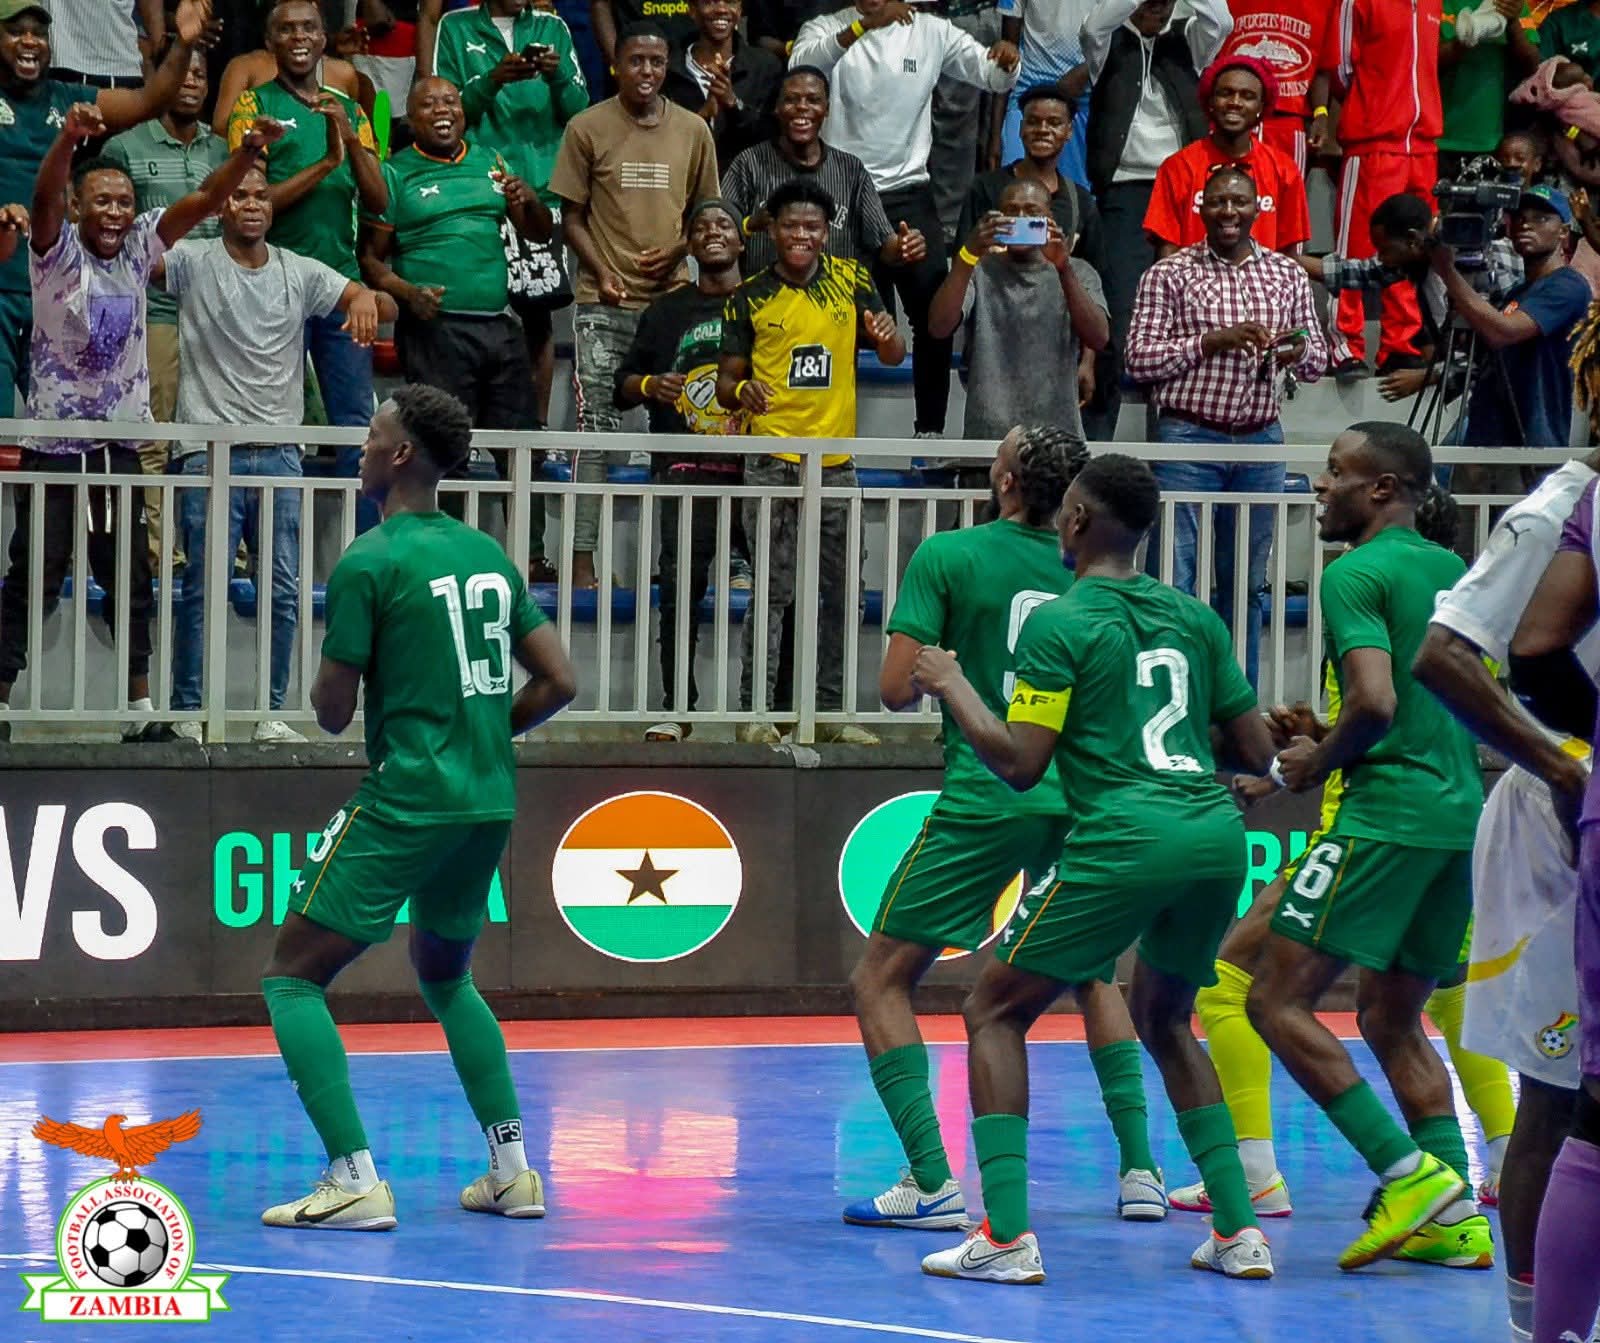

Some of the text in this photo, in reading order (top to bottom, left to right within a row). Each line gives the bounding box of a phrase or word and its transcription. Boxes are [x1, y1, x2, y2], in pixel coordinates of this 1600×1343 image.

[794, 354, 829, 378] 1&1
[429, 572, 512, 699] 13
[1135, 647, 1205, 773] 2
[0, 802, 158, 961] VS
[1293, 842, 1343, 900] 6
[498, 1121, 522, 1143] FS
